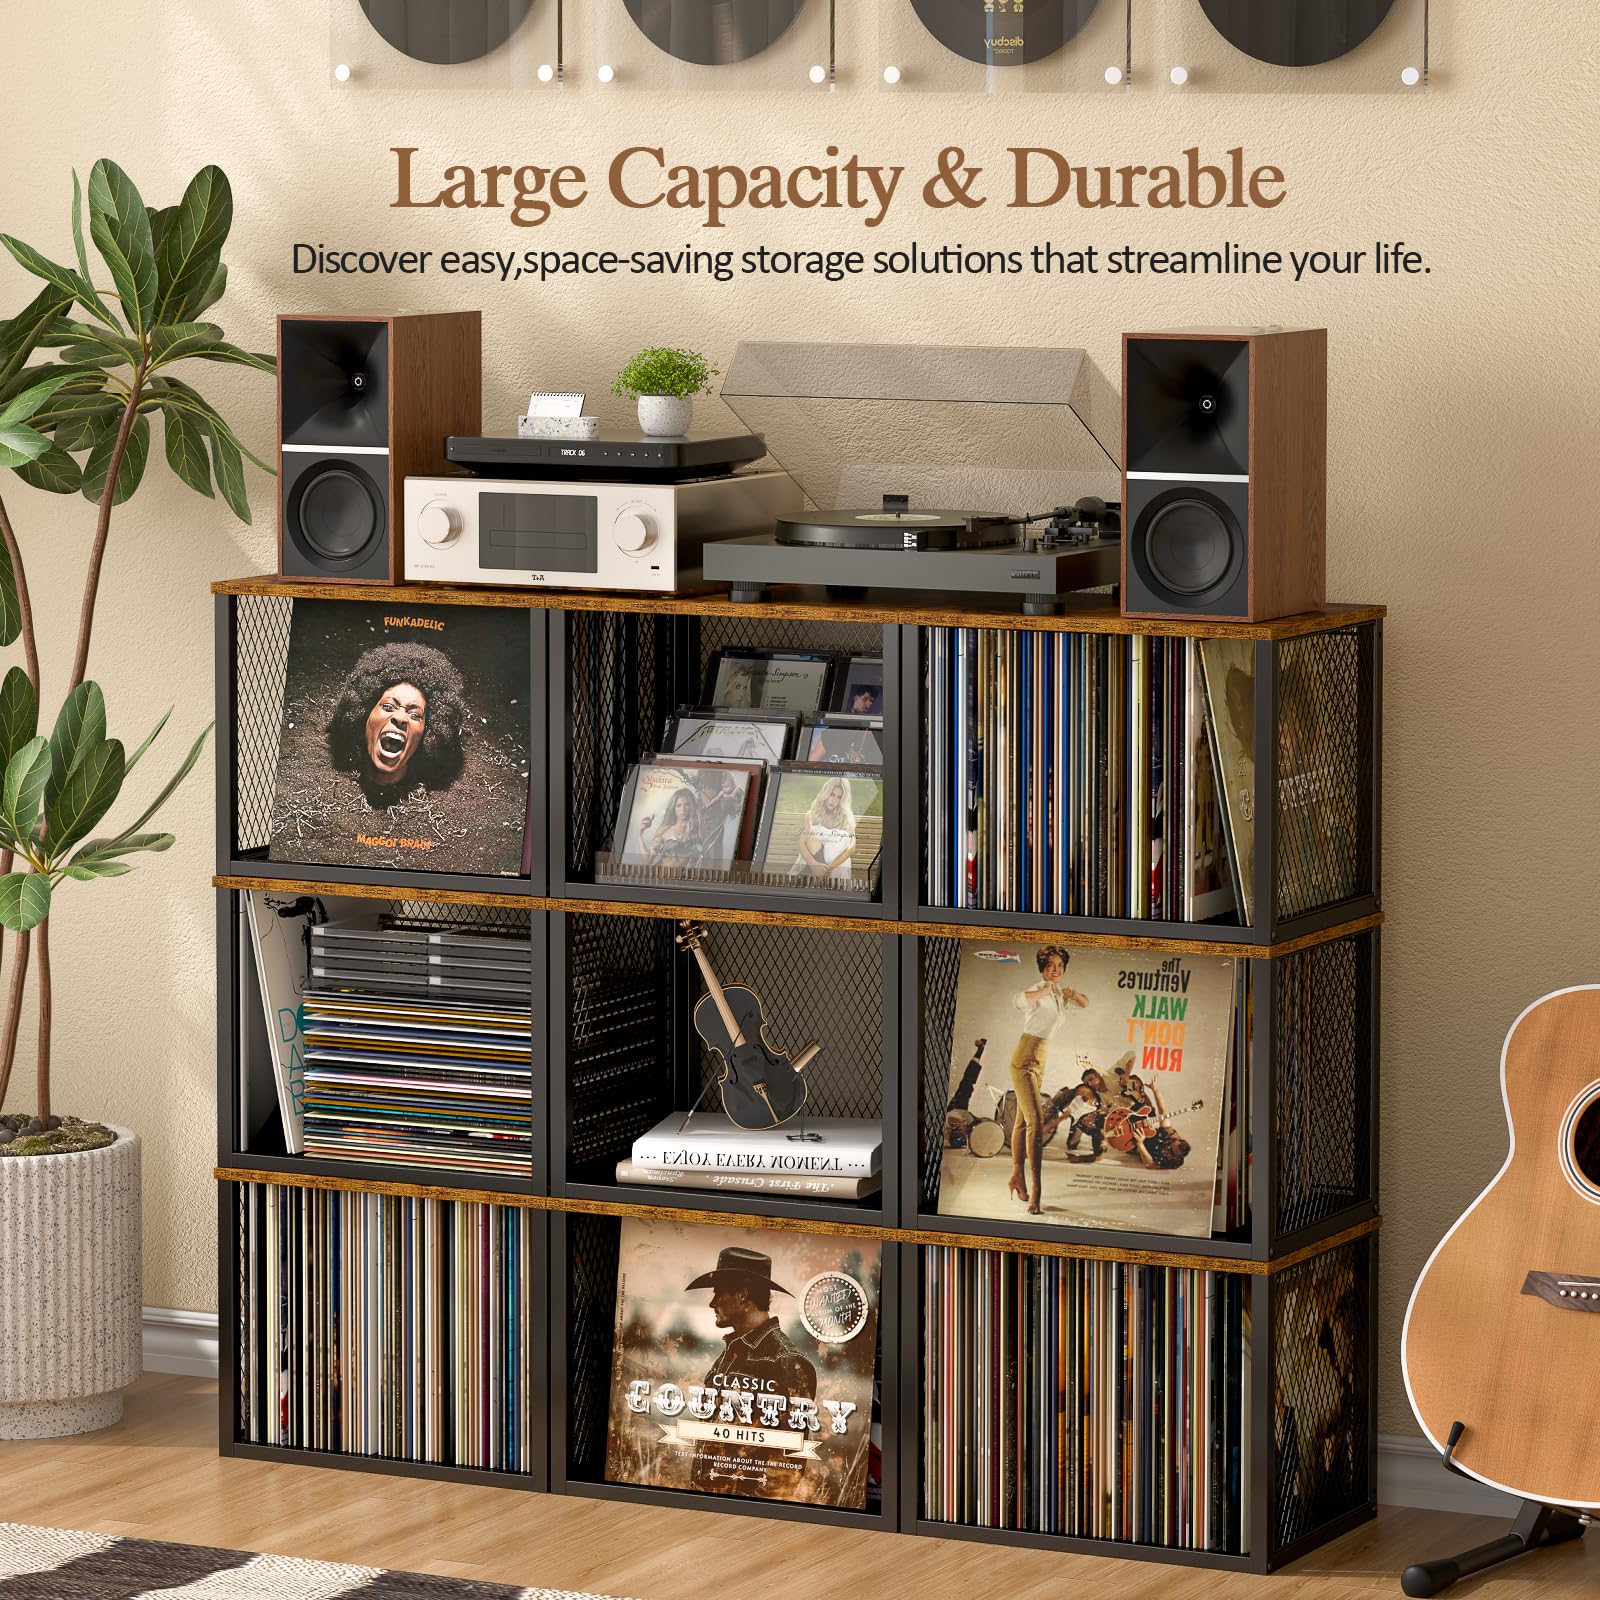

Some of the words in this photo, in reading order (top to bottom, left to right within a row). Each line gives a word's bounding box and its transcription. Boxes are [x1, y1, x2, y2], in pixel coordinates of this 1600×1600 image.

[383, 616, 445, 631] FUNKADELIC
[356, 833, 398, 848] MAGGOT
[400, 837, 431, 850] BRAIN
[712, 1174, 765, 1188] Crusade
[769, 1179, 800, 1192] First
[712, 1374, 776, 1392] CLASSIC
[624, 1379, 857, 1435] COUNTRY
[713, 1427, 731, 1439] 40
[736, 1428, 766, 1443] HITS
[689, 1452, 731, 1463] INFORMATION
[732, 1457, 753, 1465] ABOUT
[779, 1462, 803, 1470] RECORD
[713, 1461, 737, 1470] RECORD
[738, 1464, 768, 1473] COMPANY
